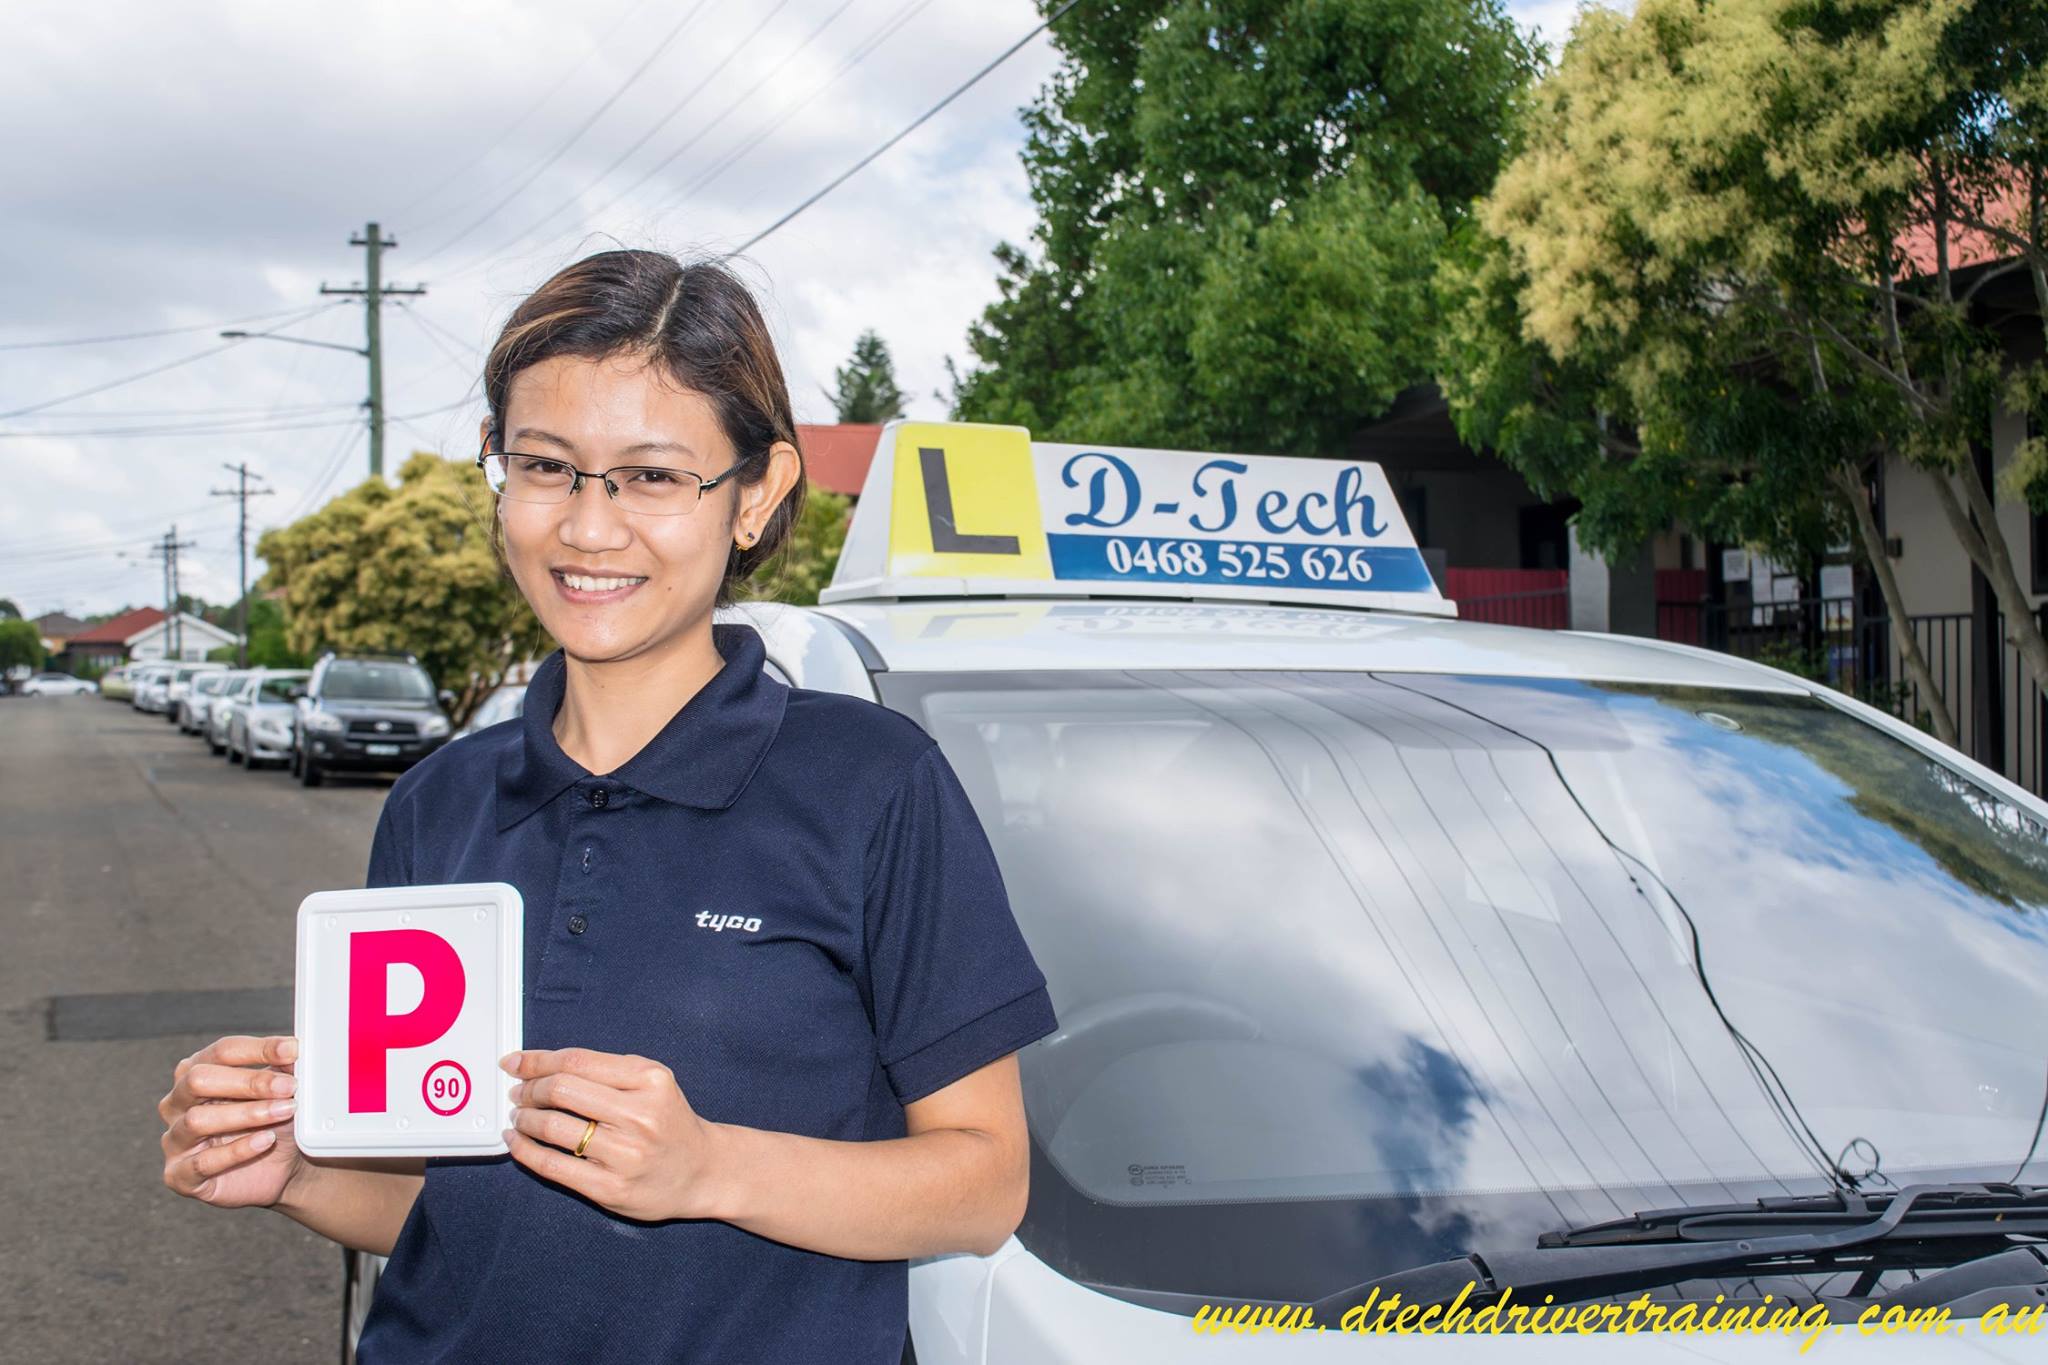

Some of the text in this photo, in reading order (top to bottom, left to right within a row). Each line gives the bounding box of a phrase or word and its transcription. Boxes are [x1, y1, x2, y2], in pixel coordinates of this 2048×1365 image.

[917, 447, 1022, 556] L
[1061, 452, 1388, 539] D-Tech
[1106, 537, 1373, 583] 0468 525 626
[694, 909, 763, 933] tyco
[348, 928, 467, 1114] P
[433, 1077, 460, 1099] 90
